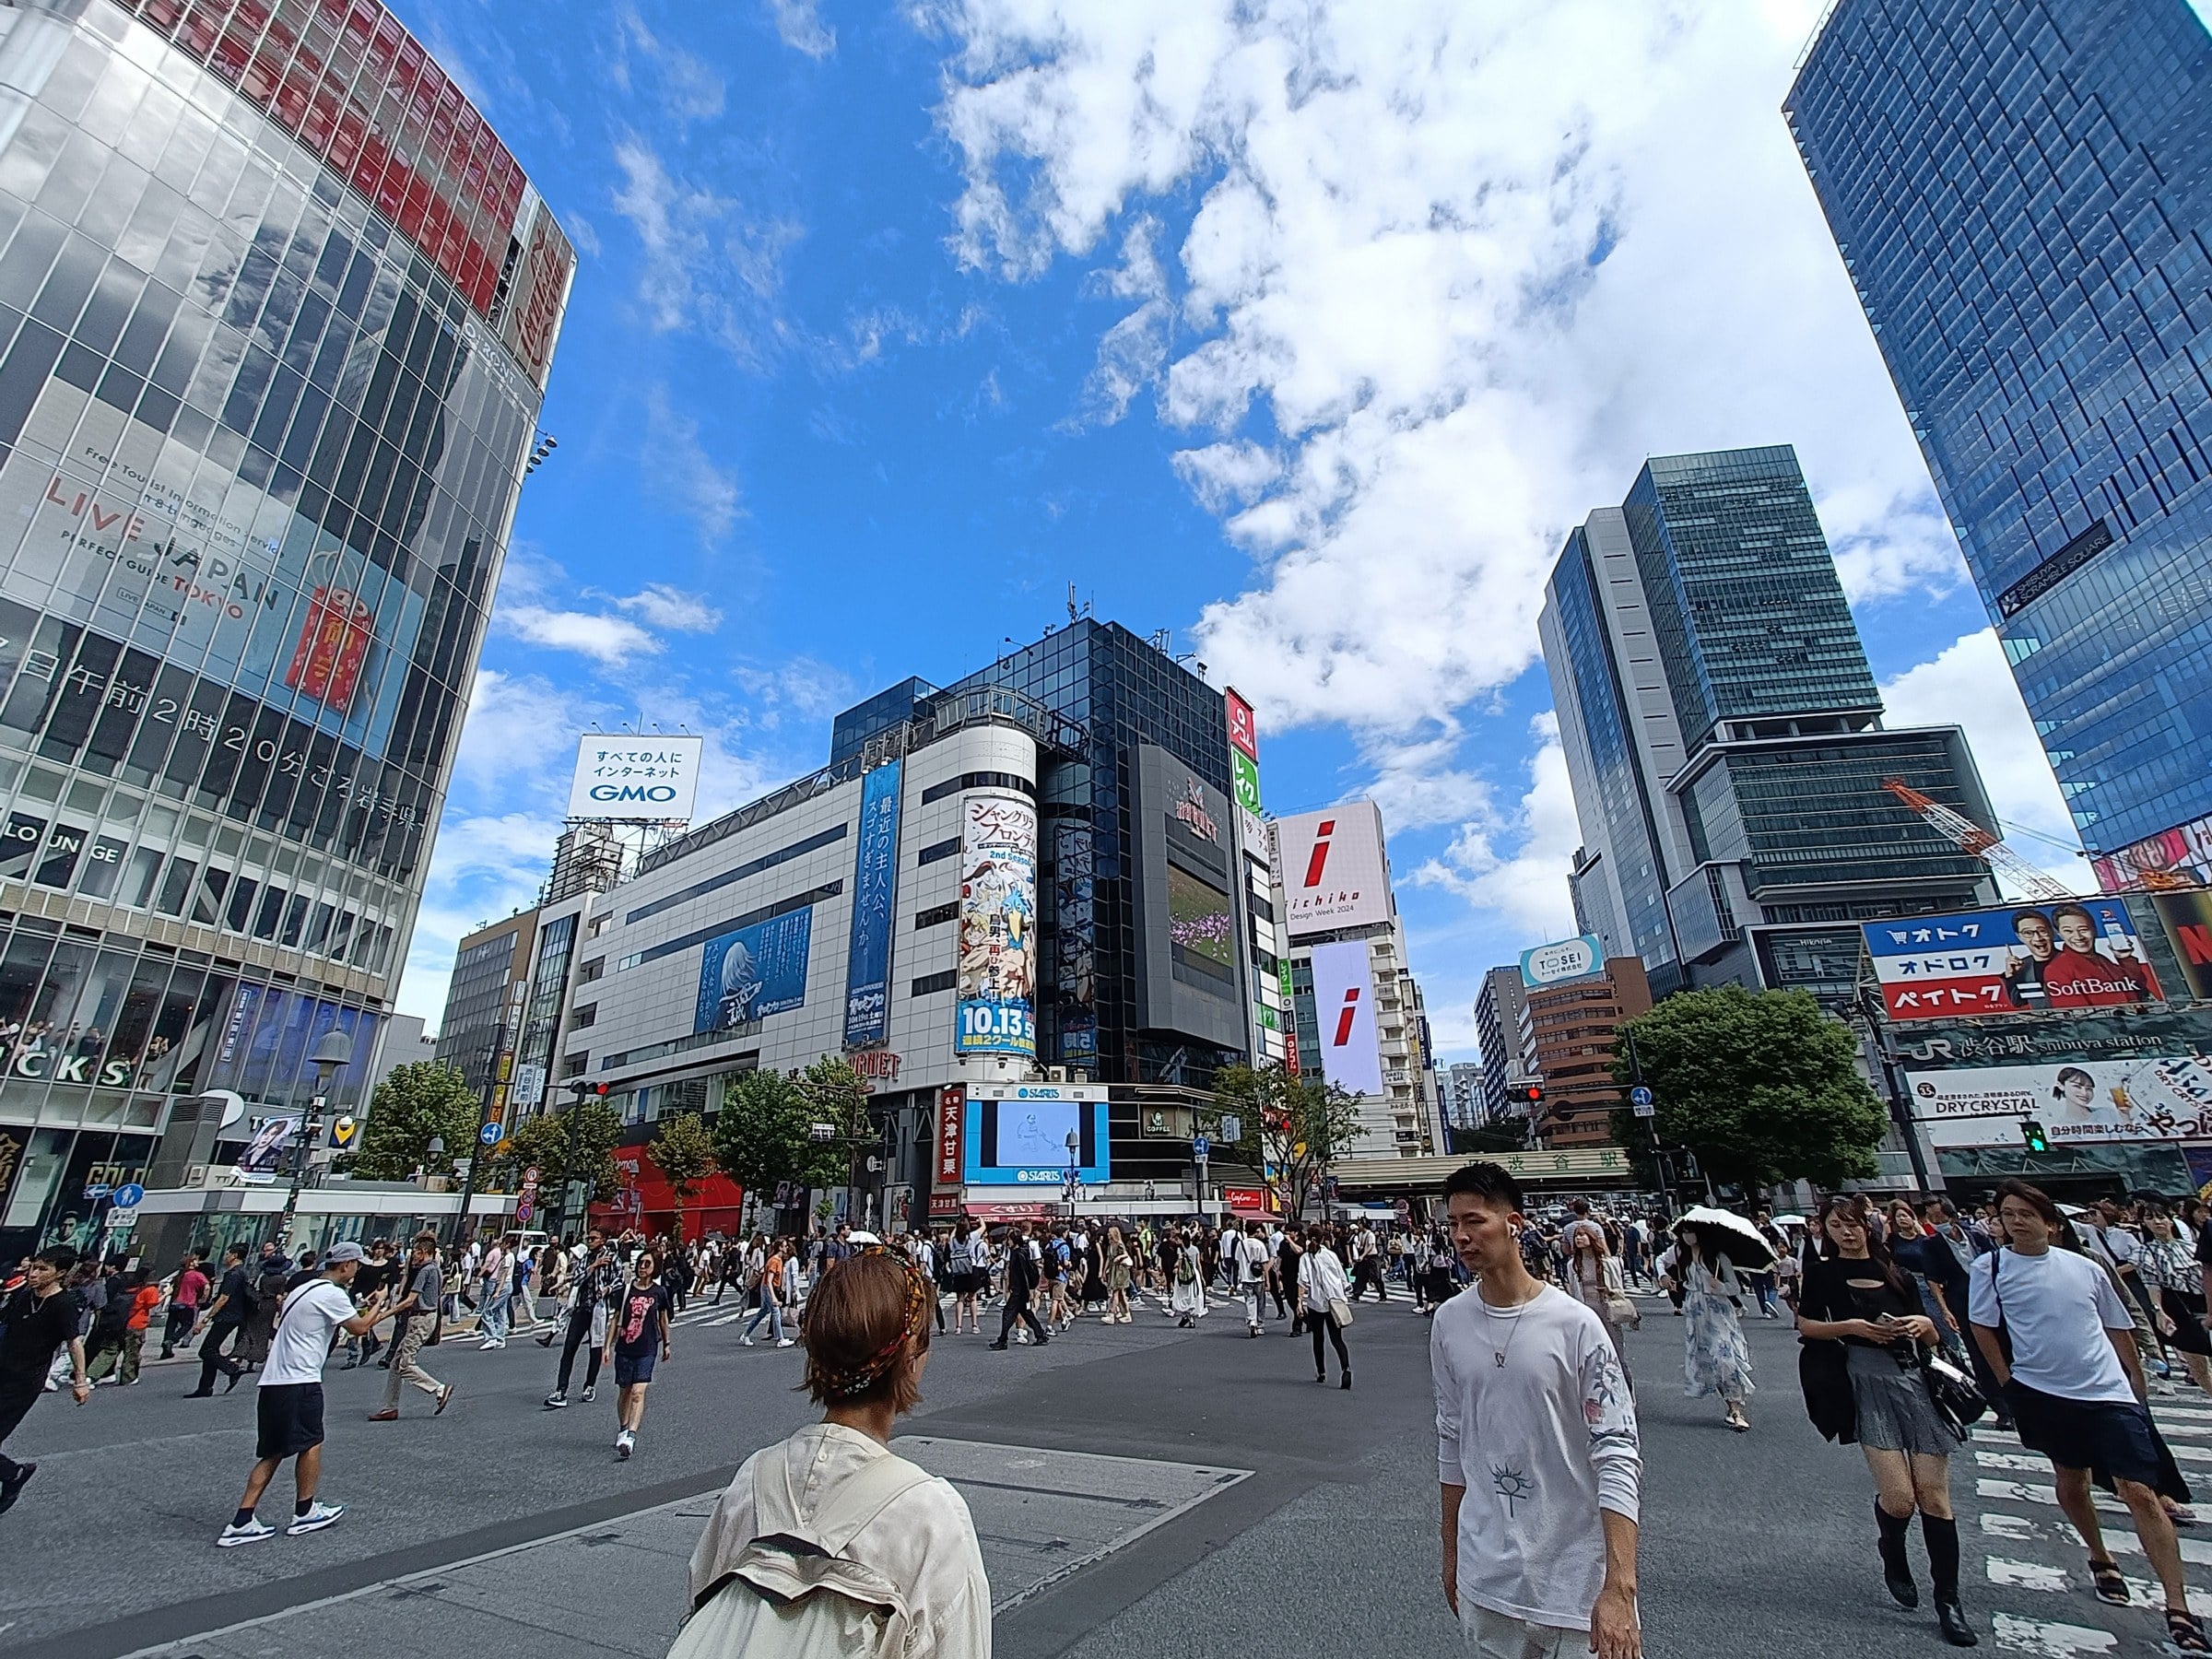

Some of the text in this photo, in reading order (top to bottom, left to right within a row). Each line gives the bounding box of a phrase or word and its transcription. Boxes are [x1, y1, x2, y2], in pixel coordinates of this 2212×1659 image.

[122, 465, 167, 495] Touist
[168, 487, 242, 535] Inormation
[596, 750, 684, 764] すべての人に
[594, 766, 680, 779] インターネット
[590, 784, 677, 802] GMO
[4, 821, 119, 864] LOUNGE
[871, 794, 893, 920] 最近の主人公、
[857, 800, 878, 957] スゴすぎませんか。
[1289, 903, 1355, 922] Design Week 2024
[1911, 924, 1981, 944] オトク
[1538, 951, 1582, 971] TOSEI
[1898, 955, 1992, 975] オドロク
[1893, 984, 2002, 1009] ペイトク
[2046, 976, 2141, 997] SoftBank
[962, 1006, 1022, 1037] 10.13
[1911, 1034, 2163, 1061] JR 渋谷駅 shibuya station
[0, 1047, 128, 1086] CKS
[847, 1051, 901, 1082] GNET
[1029, 1088, 1060, 1099] STARTS
[1936, 1098, 2041, 1113] DRY CRYSTAL
[943, 1106, 958, 1175] 天津甘栗
[1508, 1152, 1618, 1171] 渋谷駅
[1029, 1171, 1061, 1182] STARTS
